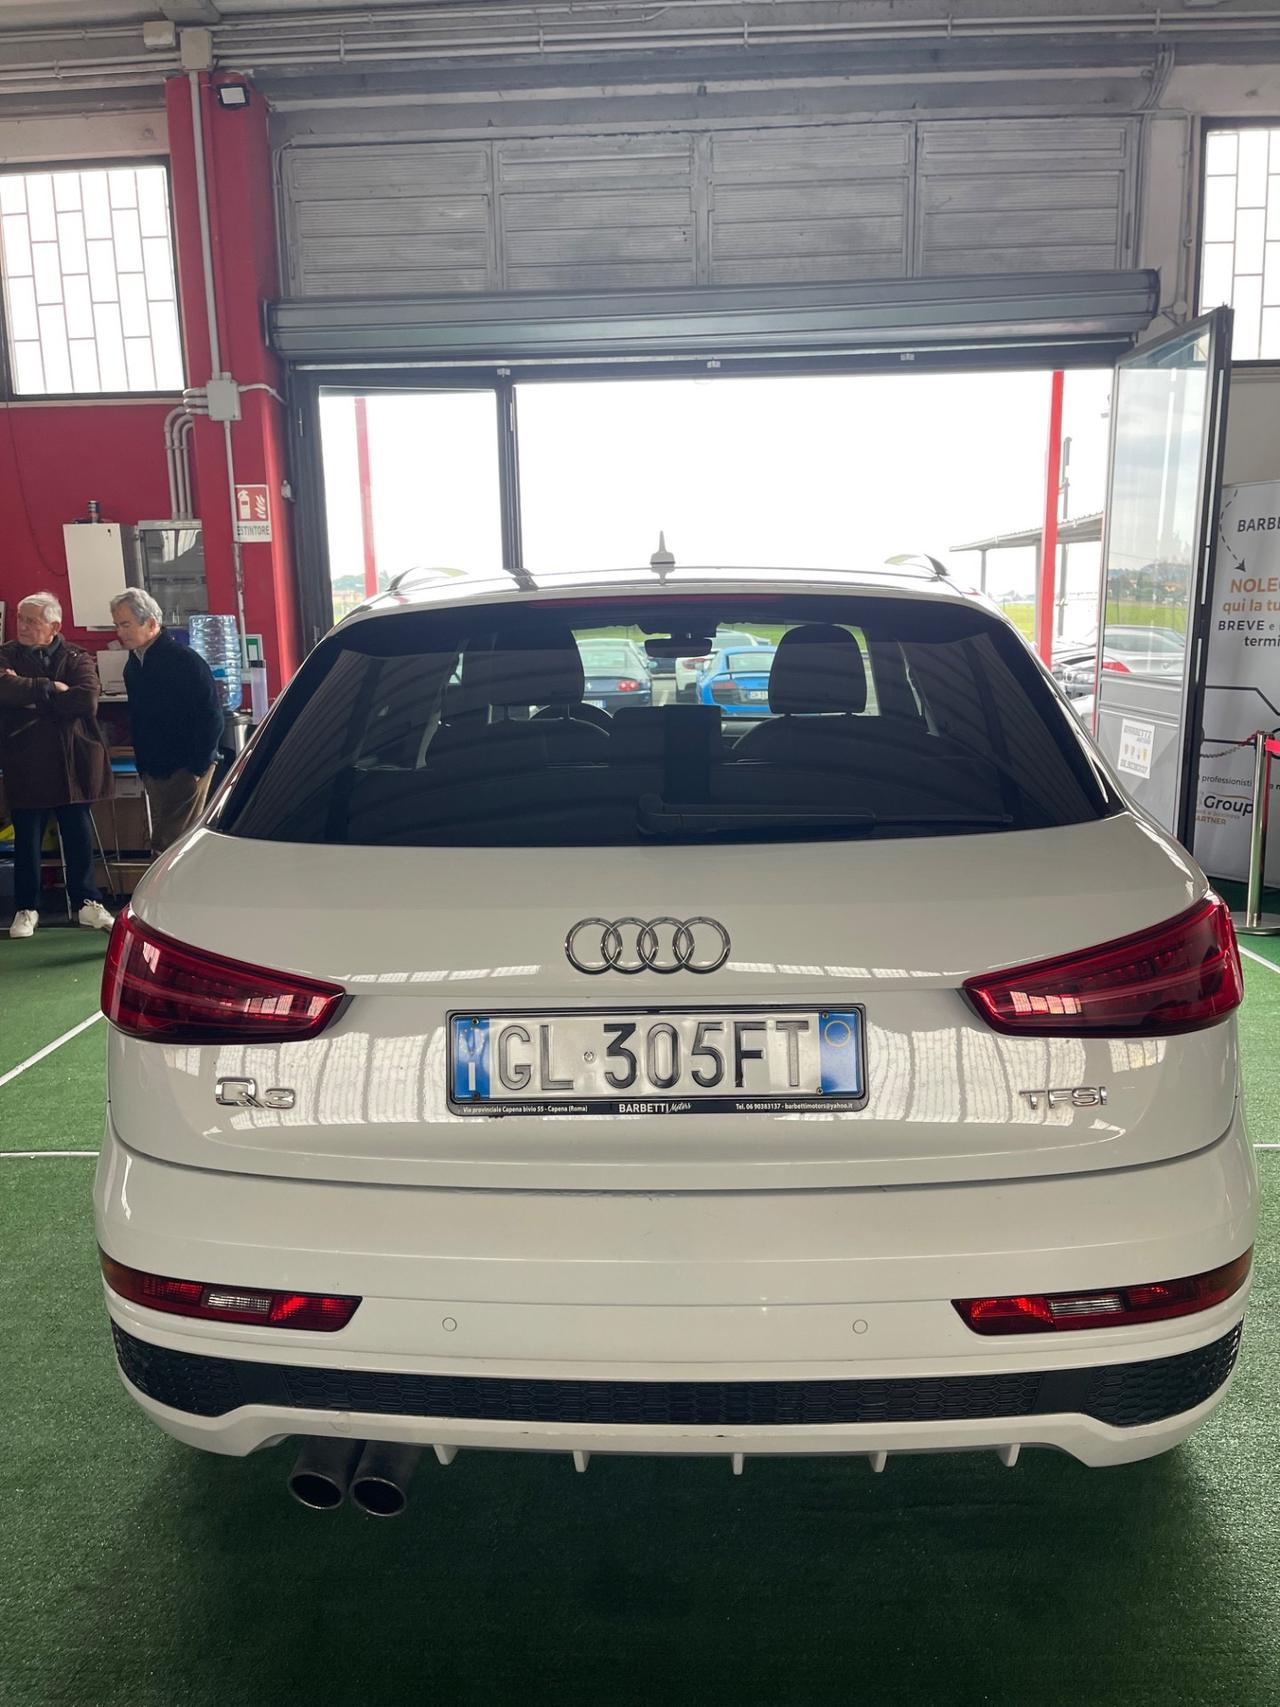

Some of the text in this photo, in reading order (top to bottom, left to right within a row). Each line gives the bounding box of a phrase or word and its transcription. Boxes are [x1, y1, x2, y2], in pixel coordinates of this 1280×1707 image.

[236, 525, 270, 536] ESTINTORE
[1237, 517, 1280, 532] BARB
[1230, 577, 1280, 593] NOLE
[1223, 598, 1245, 615] qui
[1250, 599, 1262, 611] la
[1218, 620, 1265, 631] BREVE
[1204, 795, 1253, 816] Group
[498, 1020, 810, 1091] GL 305FT
[215, 1077, 296, 1109] Q3
[1019, 1086, 1107, 1110] TFSI
[472, 1106, 501, 1114] provinciale
[502, 1106, 522, 1114] Capena
[548, 1105, 567, 1113] Capena
[568, 1105, 588, 1113] (Roma)
[618, 1103, 668, 1113] BARBETTI
